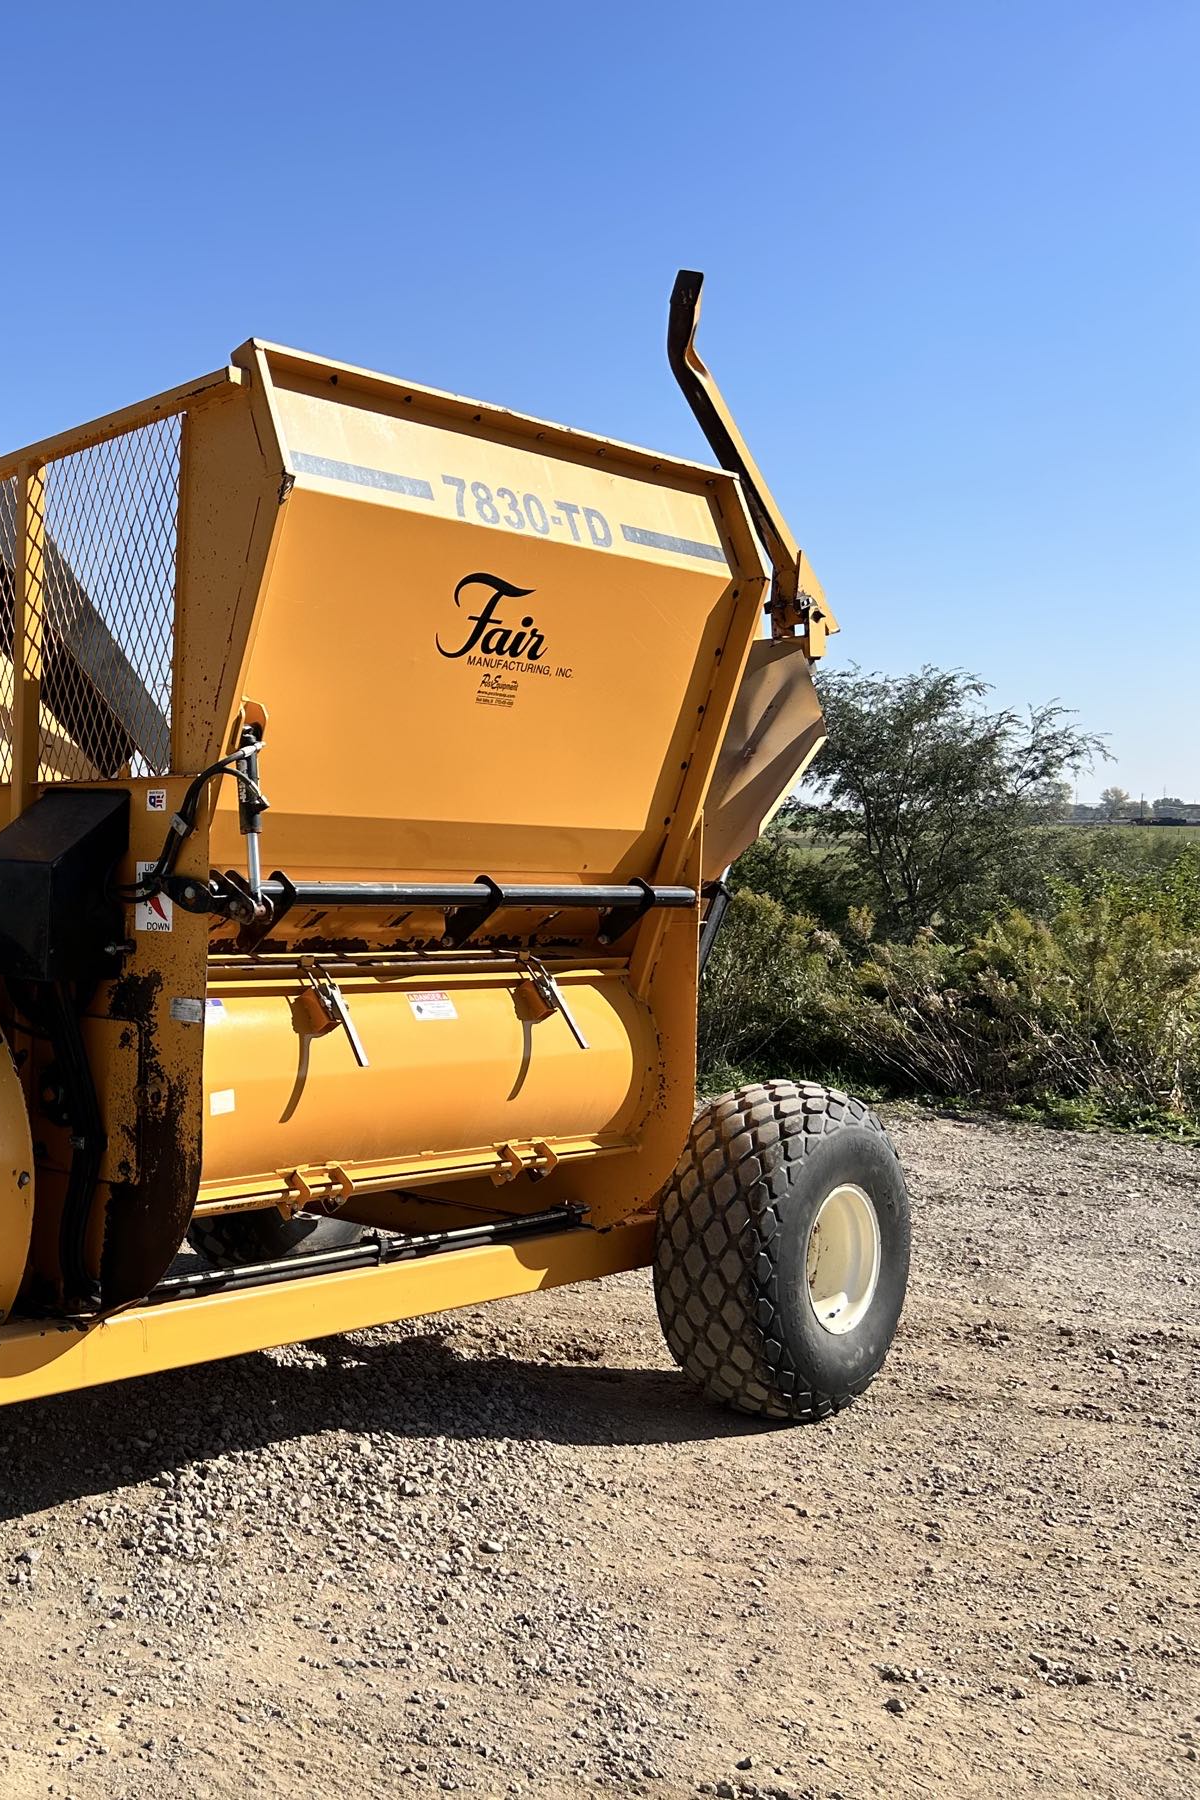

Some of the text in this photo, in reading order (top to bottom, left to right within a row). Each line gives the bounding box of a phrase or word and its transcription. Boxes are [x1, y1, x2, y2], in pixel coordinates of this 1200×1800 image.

[441, 474, 613, 549] 7830-TD
[435, 572, 549, 661] Fair
[466, 655, 574, 679] MANUFACTURING, INC.
[146, 921, 171, 931] DOWN
